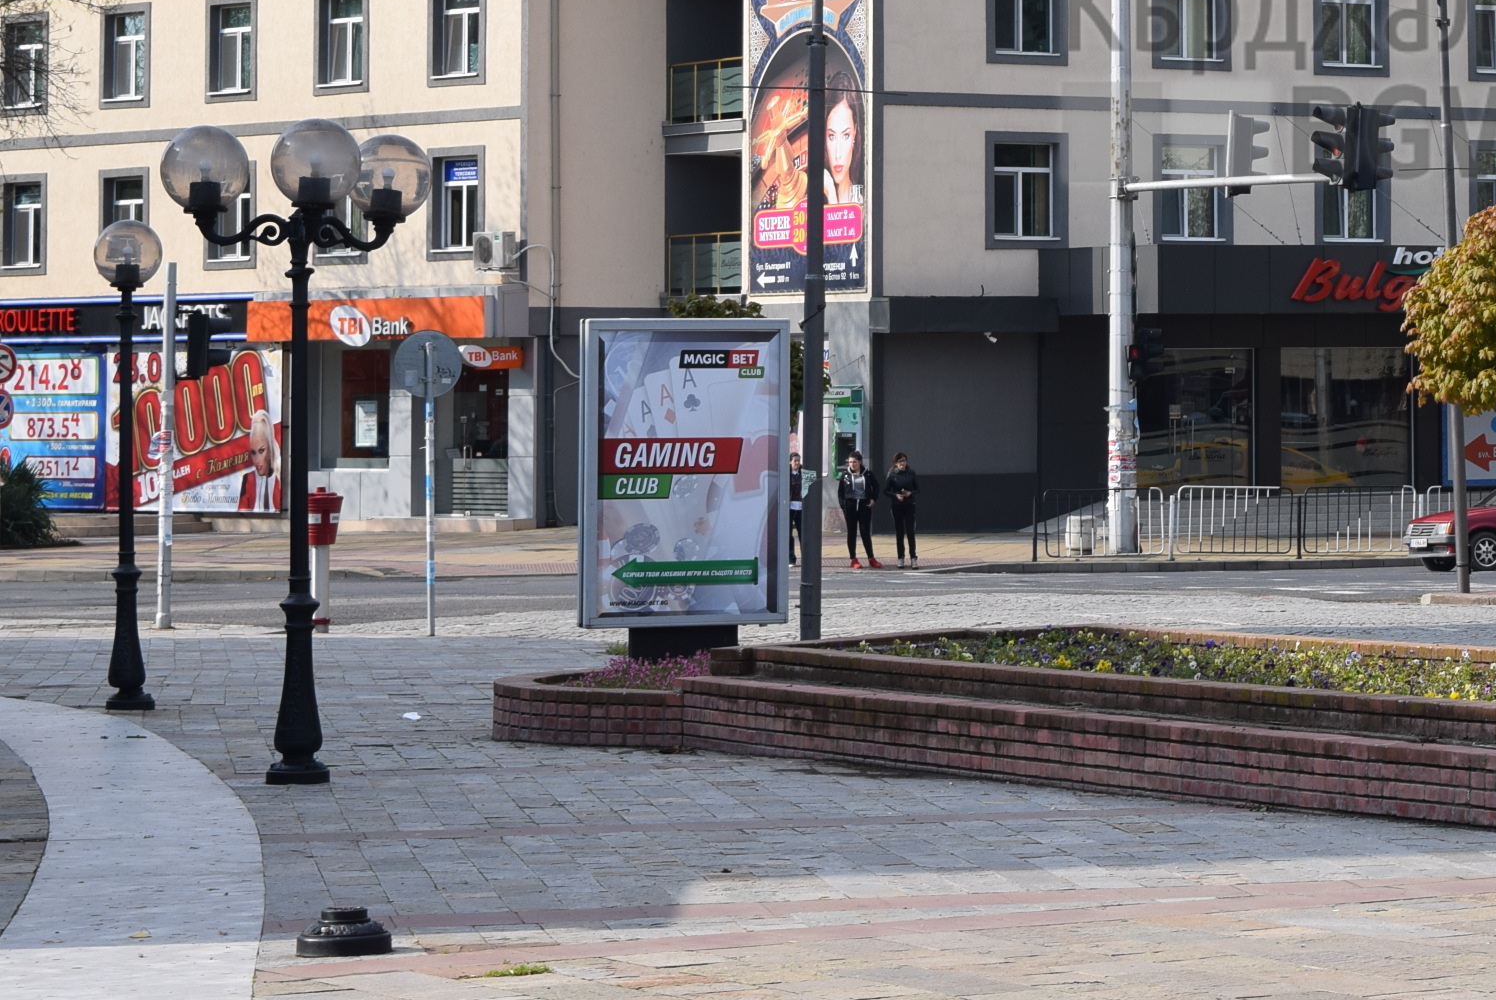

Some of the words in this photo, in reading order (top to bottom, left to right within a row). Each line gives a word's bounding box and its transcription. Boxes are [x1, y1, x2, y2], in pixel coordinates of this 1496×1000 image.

[759, 215, 791, 230] SUPER
[759, 230, 790, 242] MYSTERY
[1291, 257, 1419, 312] Bulg
[0, 308, 76, 332] ROULETTE
[337, 317, 363, 335] TBI
[372, 316, 409, 336] Bank
[467, 351, 486, 362] TBI
[492, 350, 518, 361] Bank
[683, 353, 725, 365] MAGIC
[732, 353, 756, 364] BET
[741, 368, 762, 376] CLUB
[614, 441, 716, 469] GAMING
[615, 477, 659, 495] CLUB
